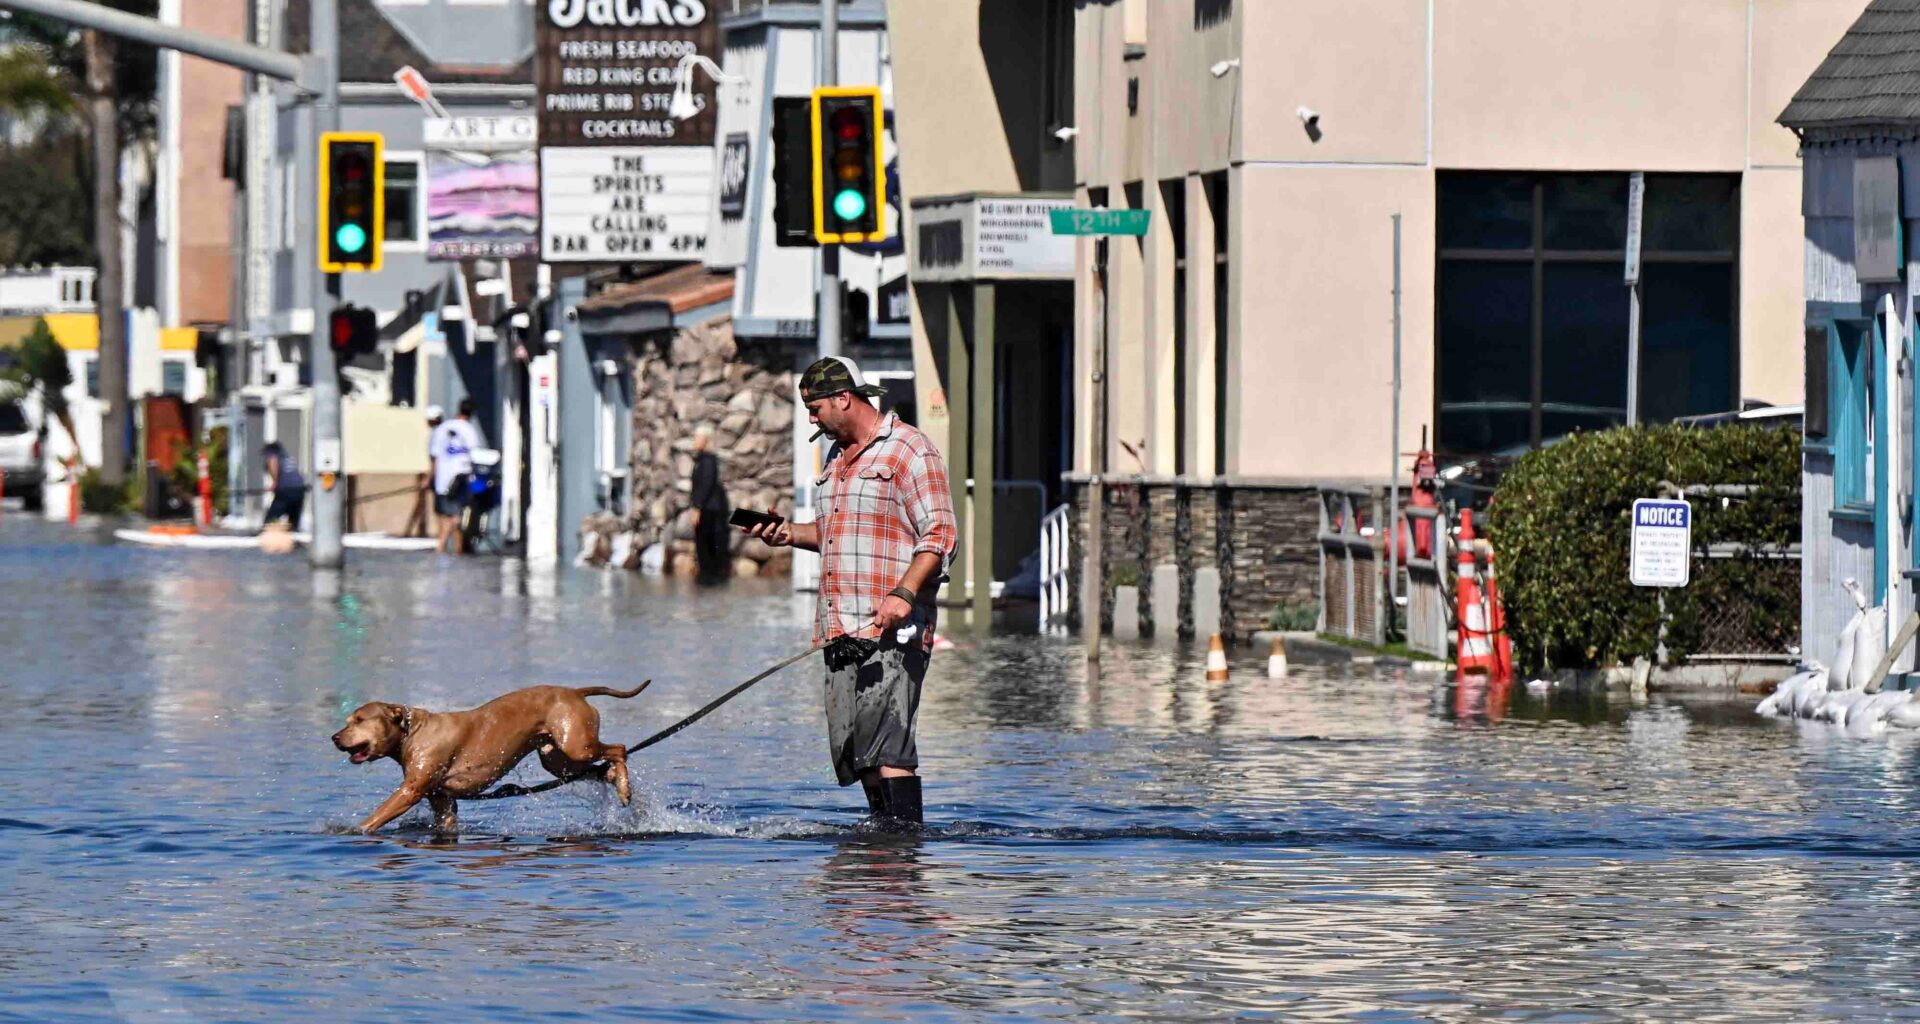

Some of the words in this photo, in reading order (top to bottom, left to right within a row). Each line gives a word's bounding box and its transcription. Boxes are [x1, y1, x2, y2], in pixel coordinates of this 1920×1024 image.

[560, 41, 613, 59] FRESH
[616, 40, 697, 59] SEAFOOD
[563, 68, 598, 85] RED
[601, 68, 645, 85] KING
[546, 94, 600, 112] PRIME
[604, 94, 634, 111] RIB
[443, 118, 497, 137] ART
[582, 120, 675, 138] COCKTAILS
[613, 156, 642, 171] THE
[593, 176, 664, 192] SPIRITS
[612, 197, 644, 212] ARE
[591, 216, 667, 232] CALLING
[552, 236, 588, 251] BAR
[605, 236, 652, 252] OPEN
[670, 235, 706, 251] 4PM
[1640, 506, 1684, 526] NOTICE
